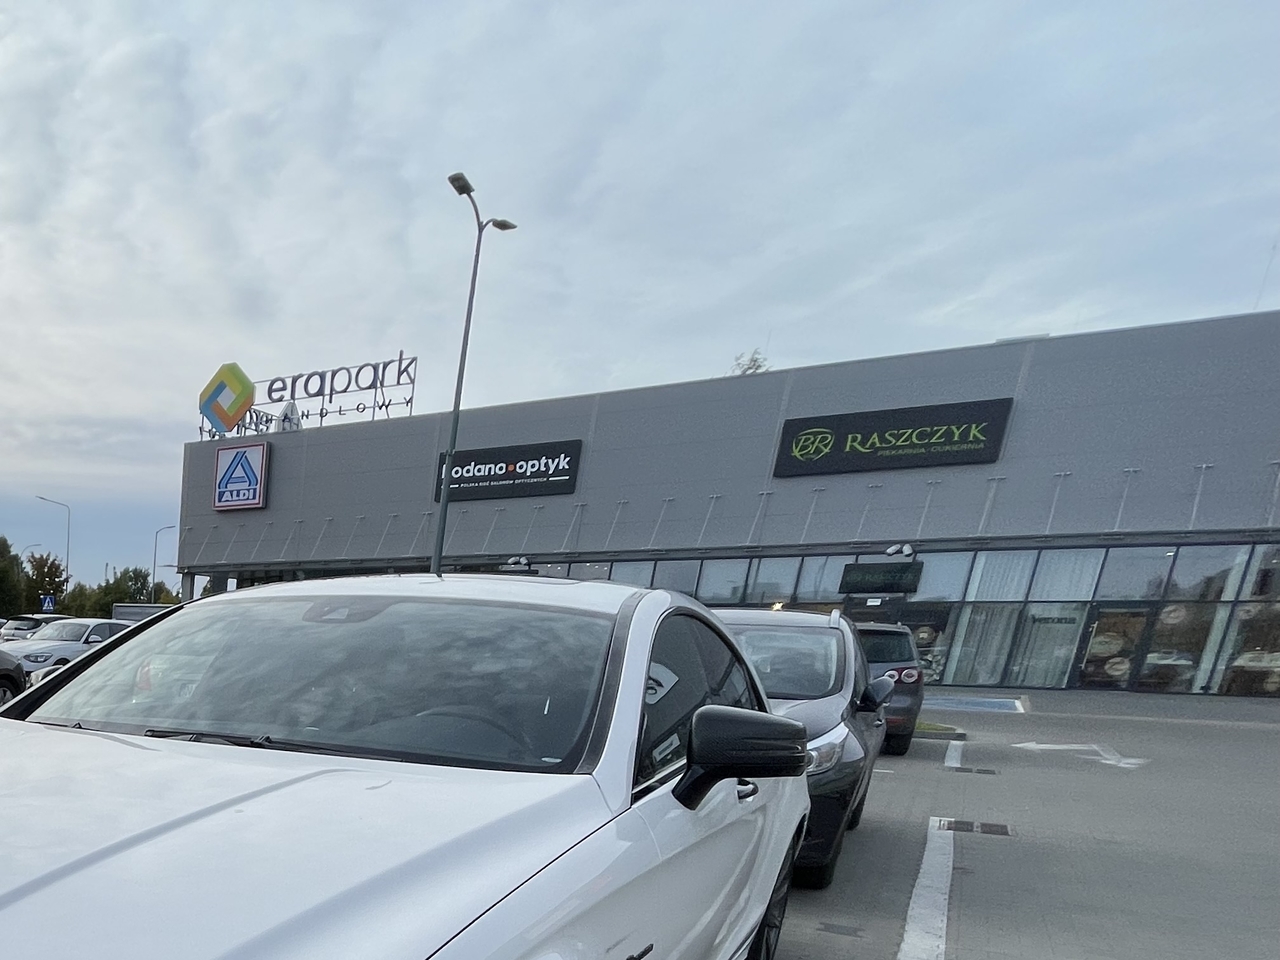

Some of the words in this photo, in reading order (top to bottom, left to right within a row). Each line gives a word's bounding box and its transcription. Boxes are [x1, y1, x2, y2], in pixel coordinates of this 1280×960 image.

[267, 349, 418, 404] erapark
[844, 423, 988, 452] RASZCZYK
[220, 489, 254, 502] ALDI
